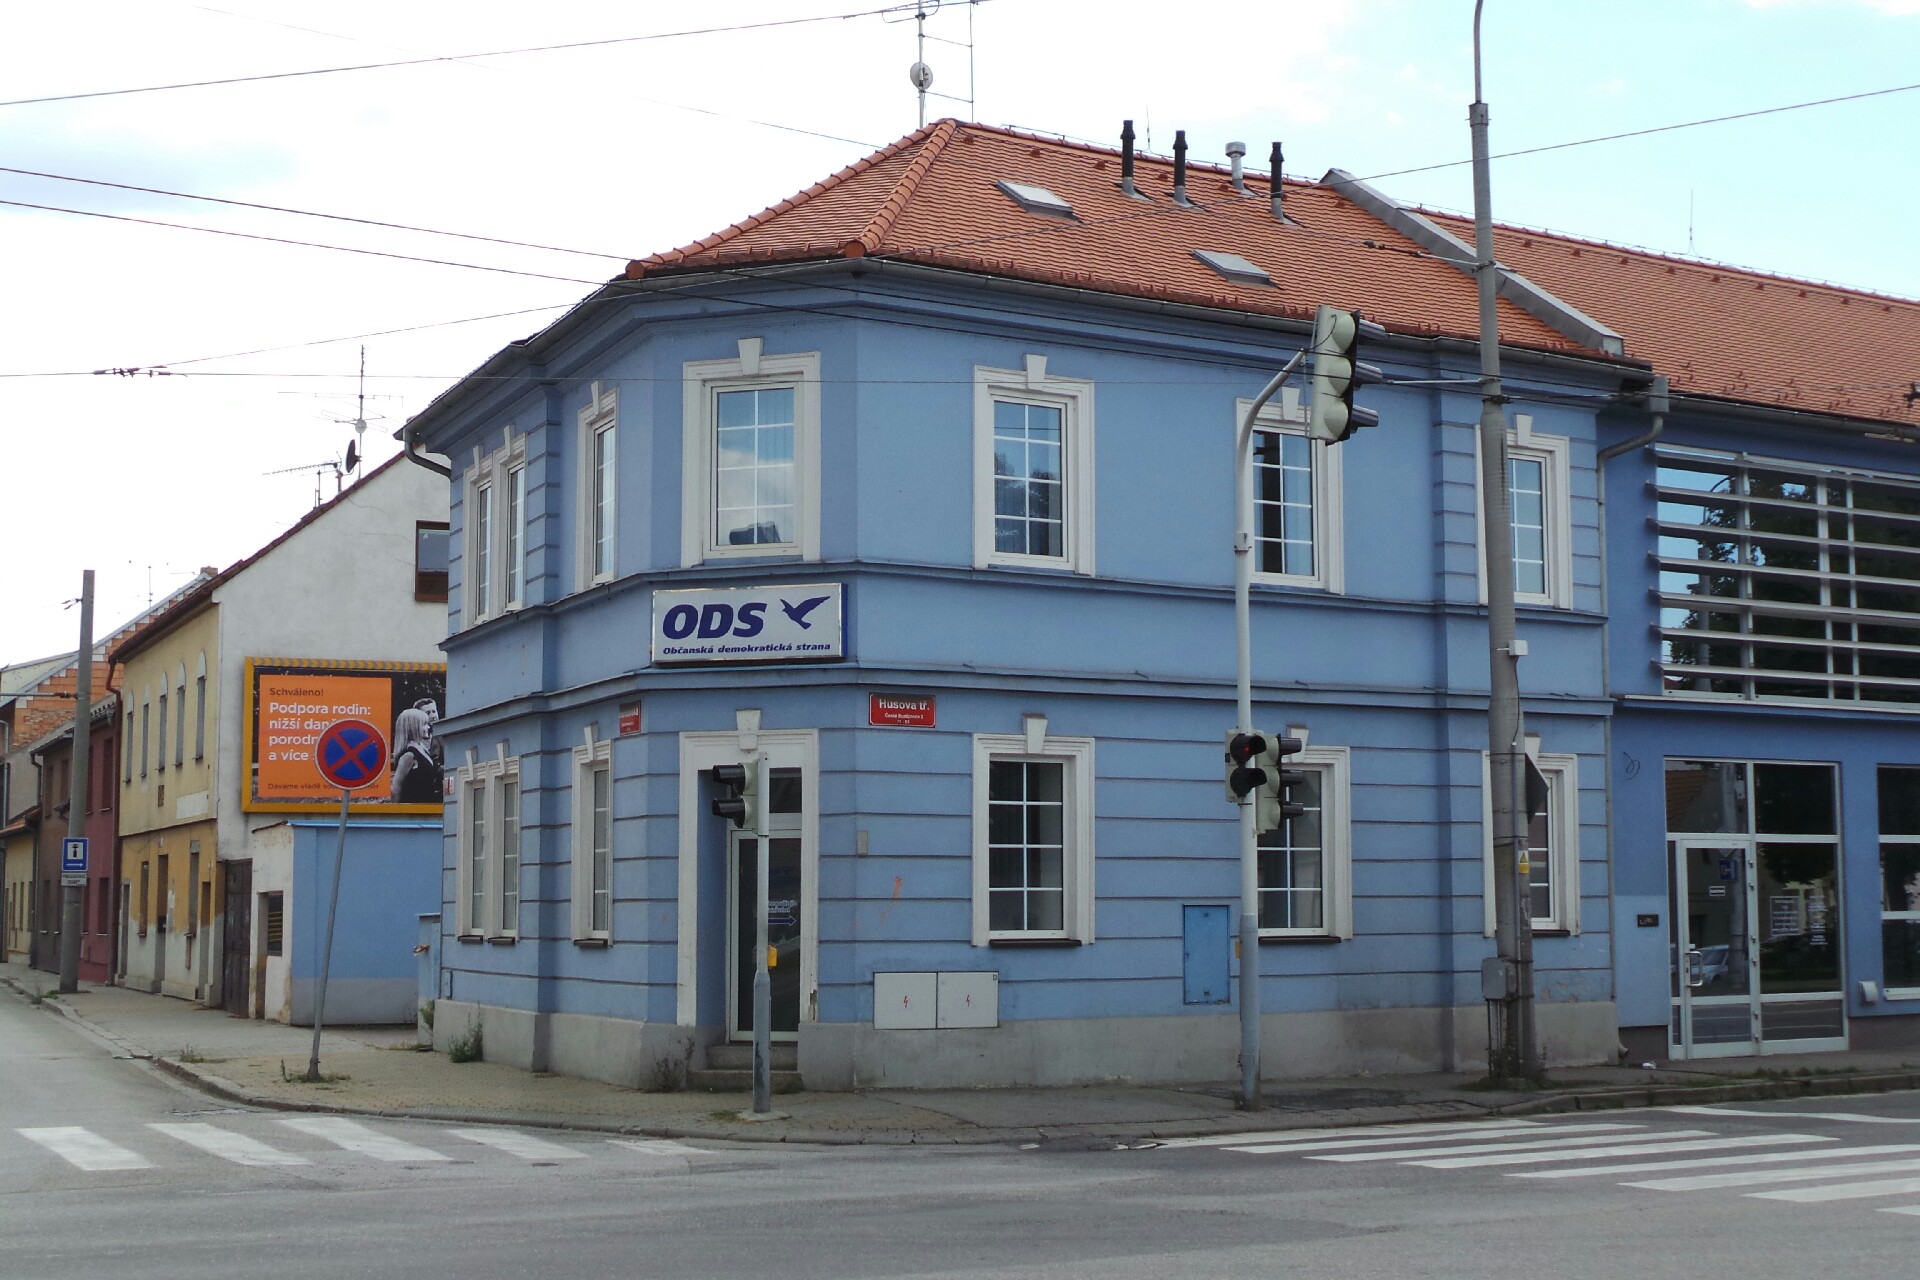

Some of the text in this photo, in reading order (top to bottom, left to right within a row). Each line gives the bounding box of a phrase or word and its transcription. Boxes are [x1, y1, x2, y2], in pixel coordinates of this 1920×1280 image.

[662, 602, 768, 640] ODS
[663, 642, 831, 655] Občanská demokratická strana
[269, 687, 324, 697] Schváleno!
[269, 702, 371, 715] Podpora rodin:
[879, 699, 929, 710] Husova tř.
[269, 717, 300, 730] nižší
[269, 749, 309, 761] a více
